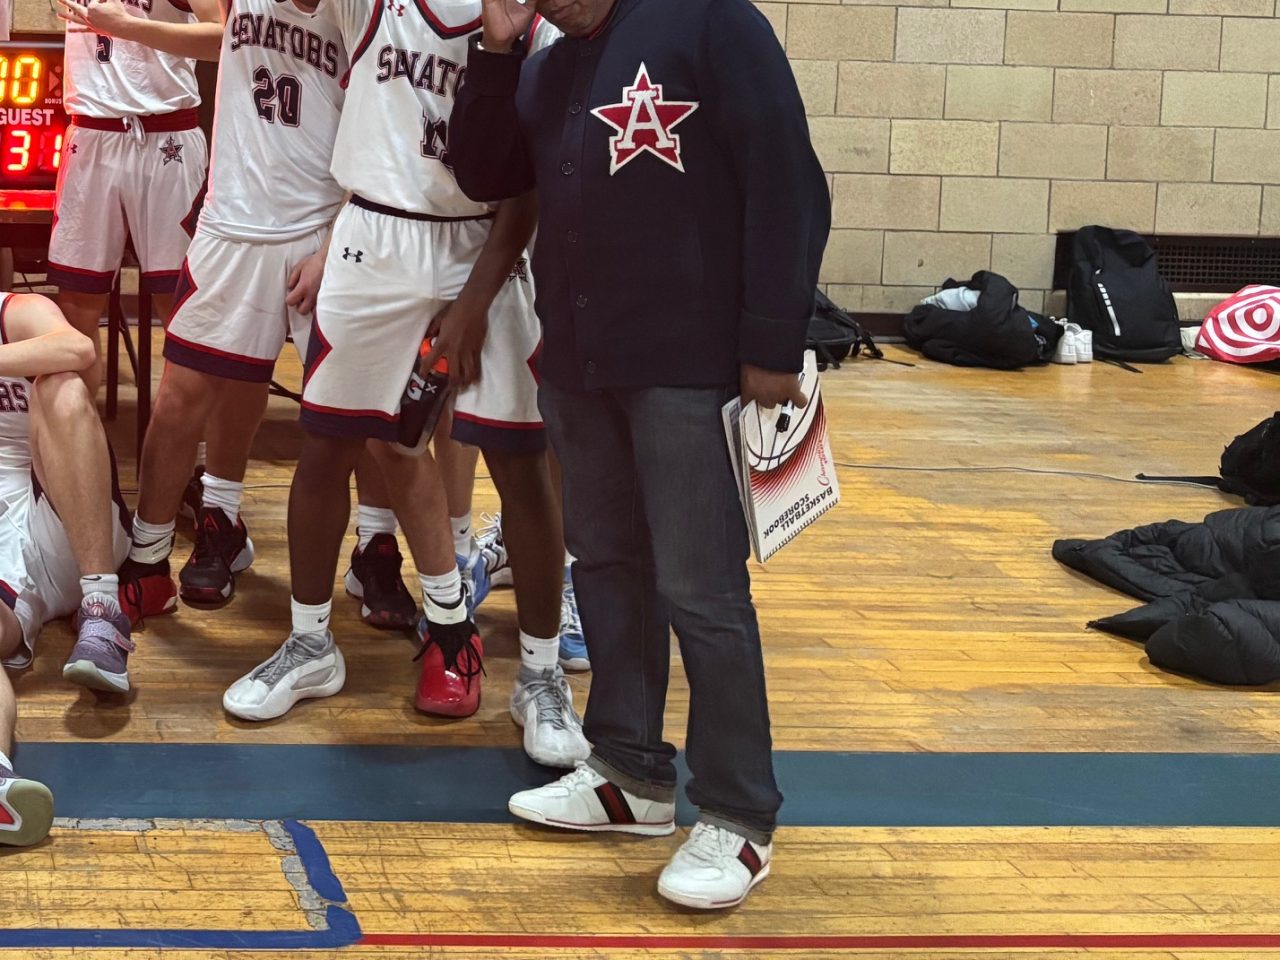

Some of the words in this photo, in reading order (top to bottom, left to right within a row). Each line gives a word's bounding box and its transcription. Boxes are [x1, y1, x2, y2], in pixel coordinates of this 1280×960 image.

[231, 11, 339, 79] SENATORS
[376, 44, 467, 100] SENATO
[252, 65, 303, 128] 20
[616, 90, 676, 150] A
[6, 129, 63, 171] 31
[763, 494, 810, 539] SCOREBOOK
[781, 486, 833, 531] BASKETBALL
